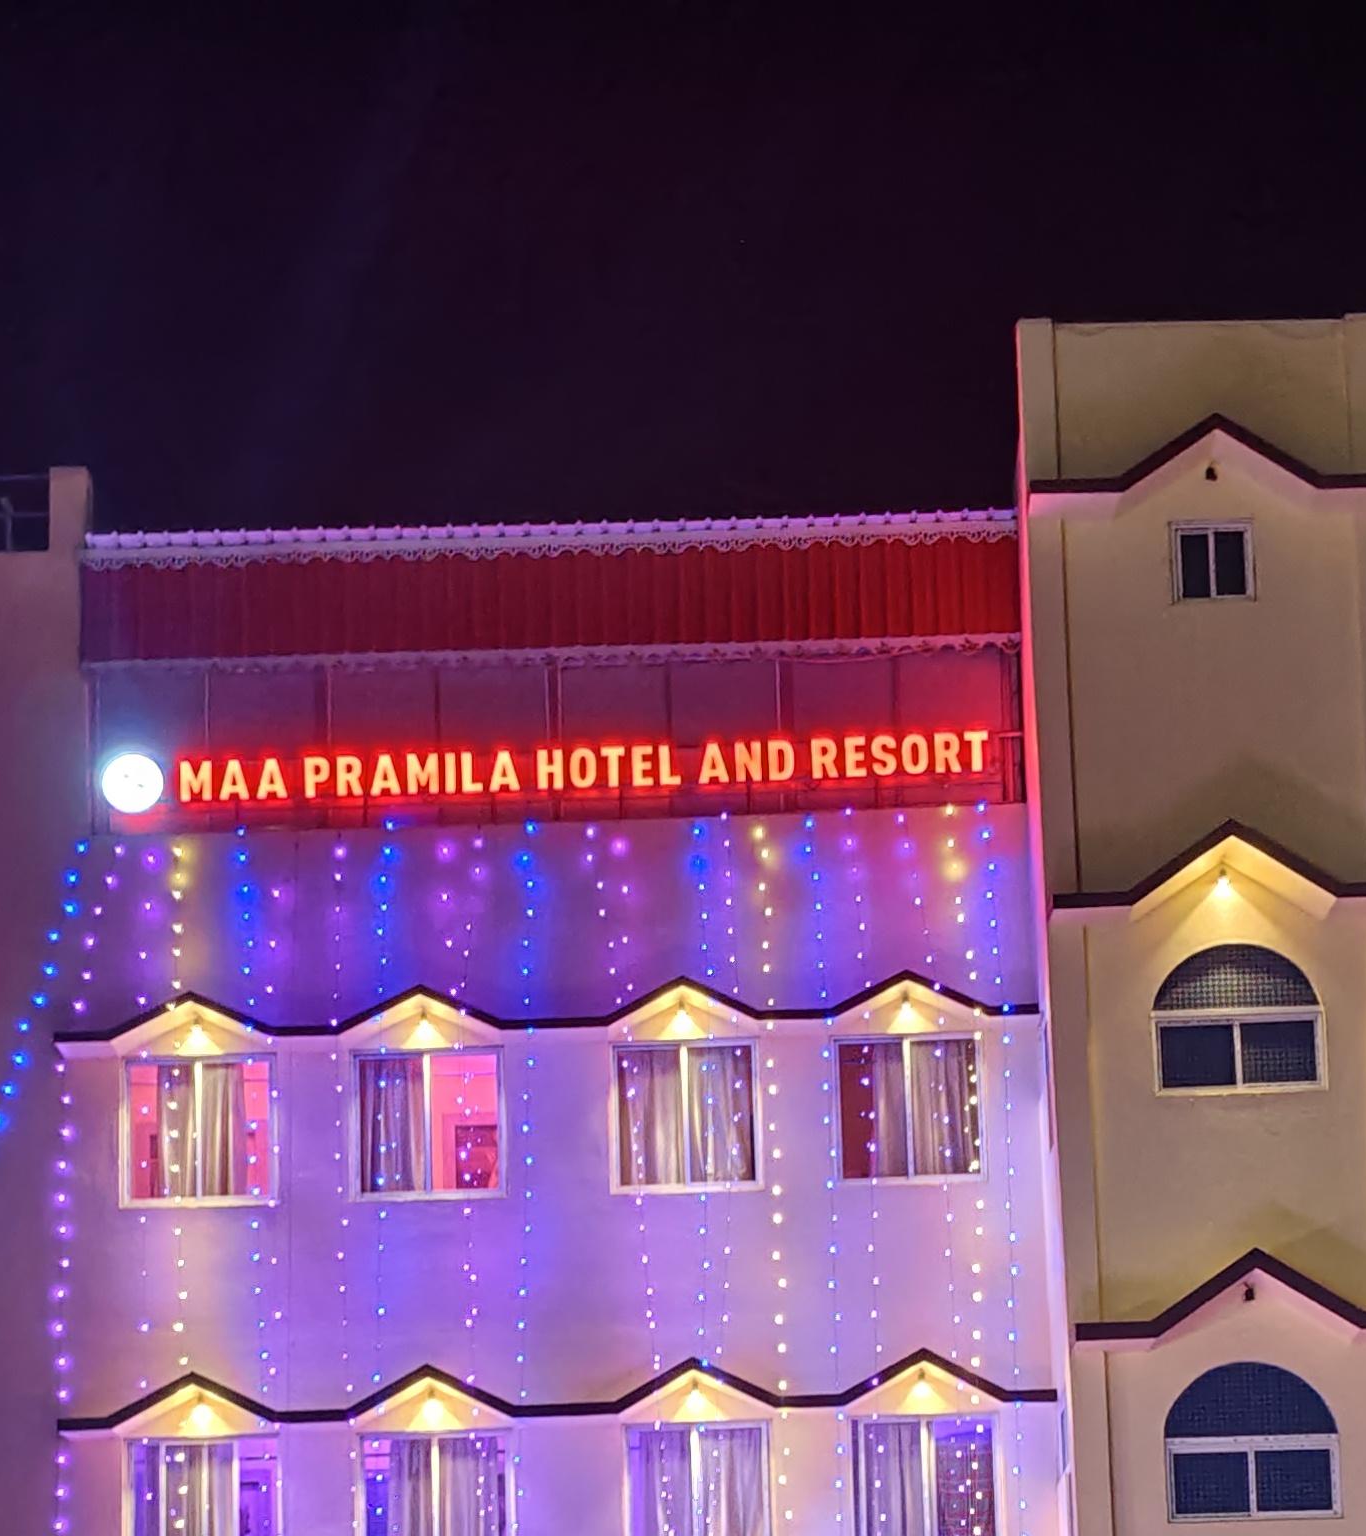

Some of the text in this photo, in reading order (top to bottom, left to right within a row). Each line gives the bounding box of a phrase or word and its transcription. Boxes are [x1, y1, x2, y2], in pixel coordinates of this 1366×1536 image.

[179, 730, 989, 802] MAA PRAMILA HOTEL AND RESORT
